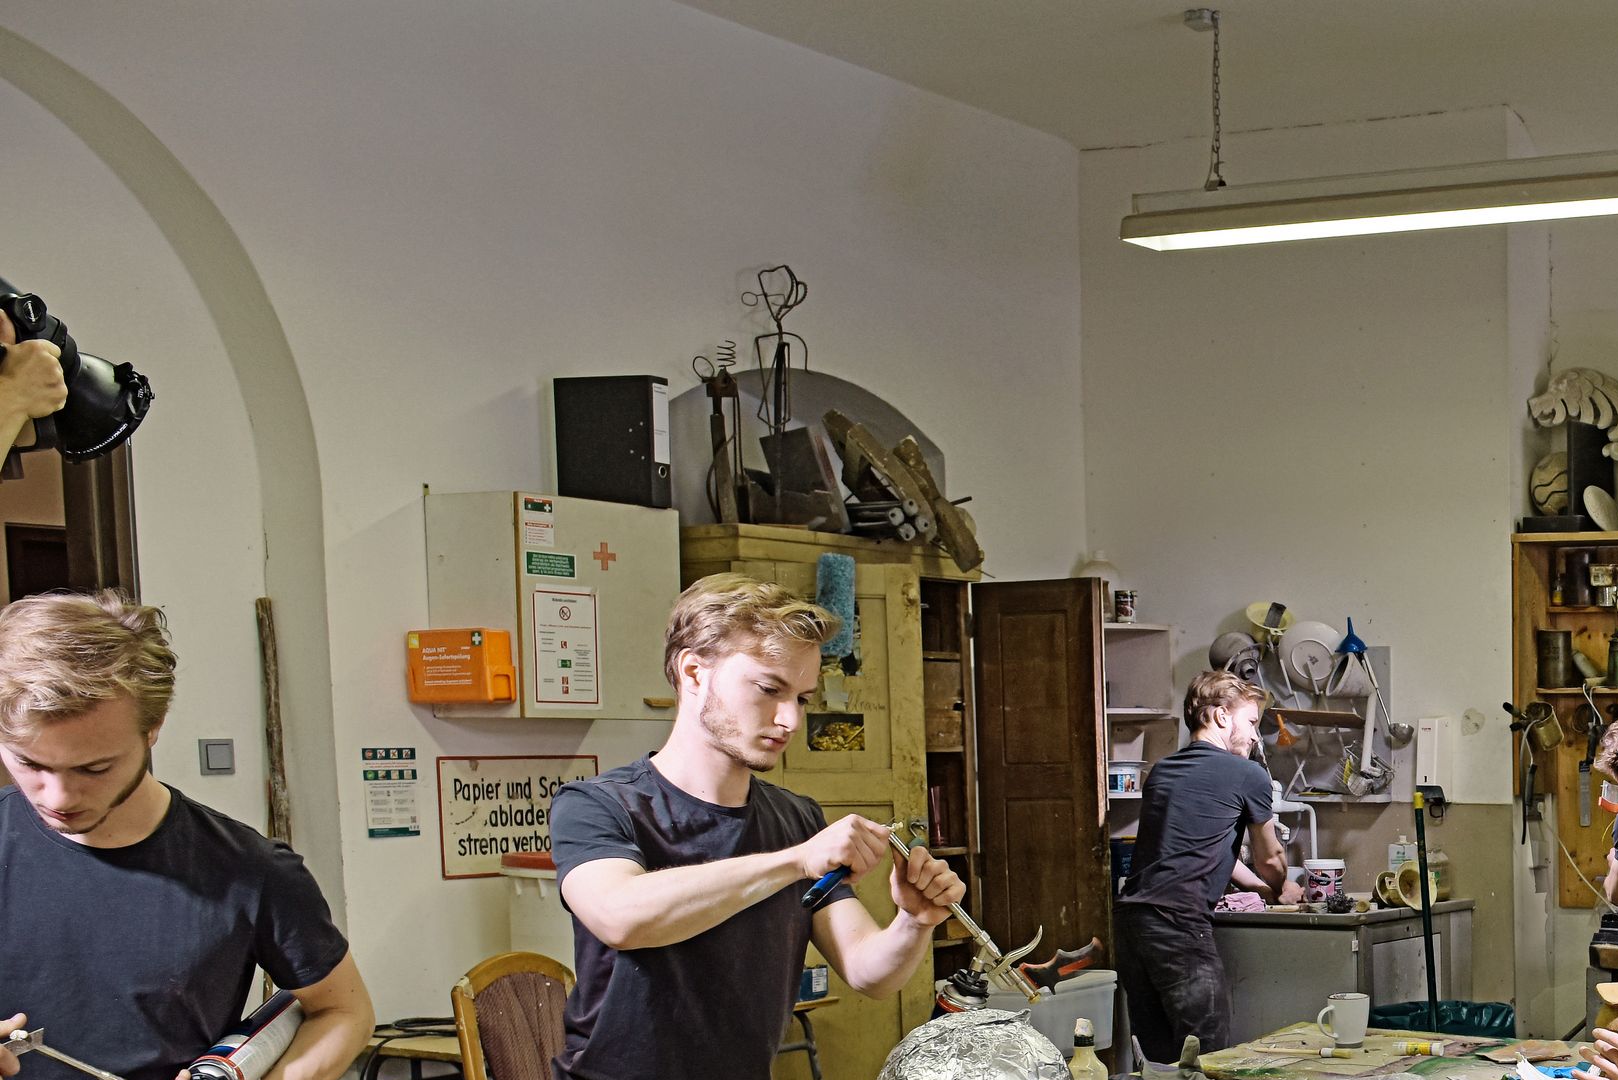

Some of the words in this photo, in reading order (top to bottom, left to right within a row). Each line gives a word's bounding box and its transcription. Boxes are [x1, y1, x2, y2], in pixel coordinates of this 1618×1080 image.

[453, 778, 501, 805] Papier
[507, 777, 532, 800] und
[512, 830, 552, 852] verbo
